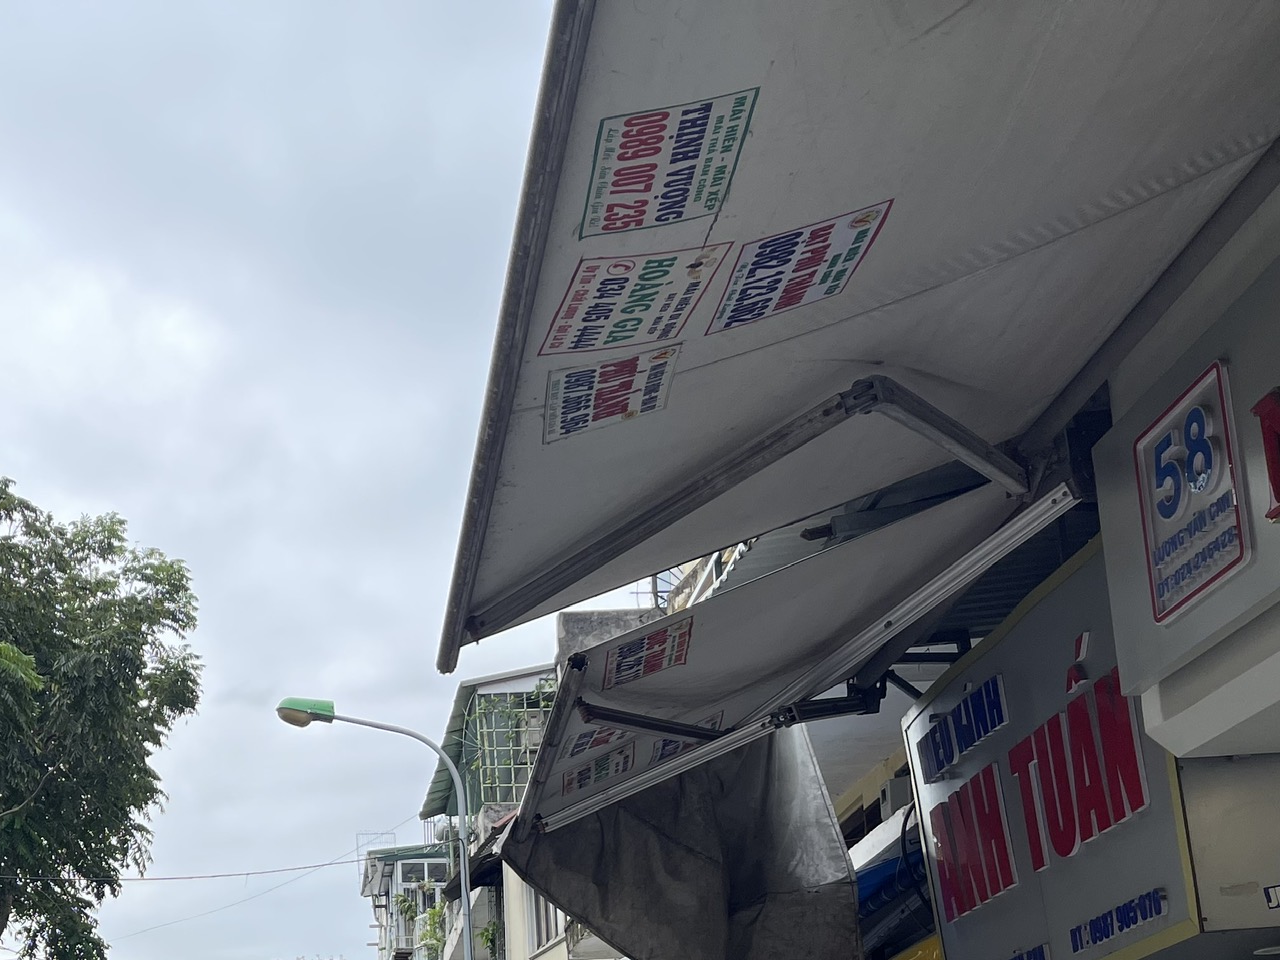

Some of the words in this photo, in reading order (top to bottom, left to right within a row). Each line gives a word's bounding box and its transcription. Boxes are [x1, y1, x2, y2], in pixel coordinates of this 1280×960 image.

[729, 95, 748, 123] MÁI
[616, 111, 670, 162] 0989
[668, 101, 714, 165] THỊNH
[719, 122, 740, 155] HIÊN
[609, 162, 658, 196] 007
[710, 163, 728, 190] MÁI
[653, 164, 697, 223] VƯỢNG
[601, 199, 649, 232] 235
[592, 276, 630, 300] 034
[621, 256, 678, 315] HOÀNG
[581, 301, 617, 324] 405
[567, 324, 606, 350] 4444
[602, 317, 645, 346] GIA
[1153, 406, 1213, 521] 58
[950, 673, 1010, 756] KÍNH
[929, 761, 1019, 923] ANH
[1007, 631, 1150, 873] TUẤN
